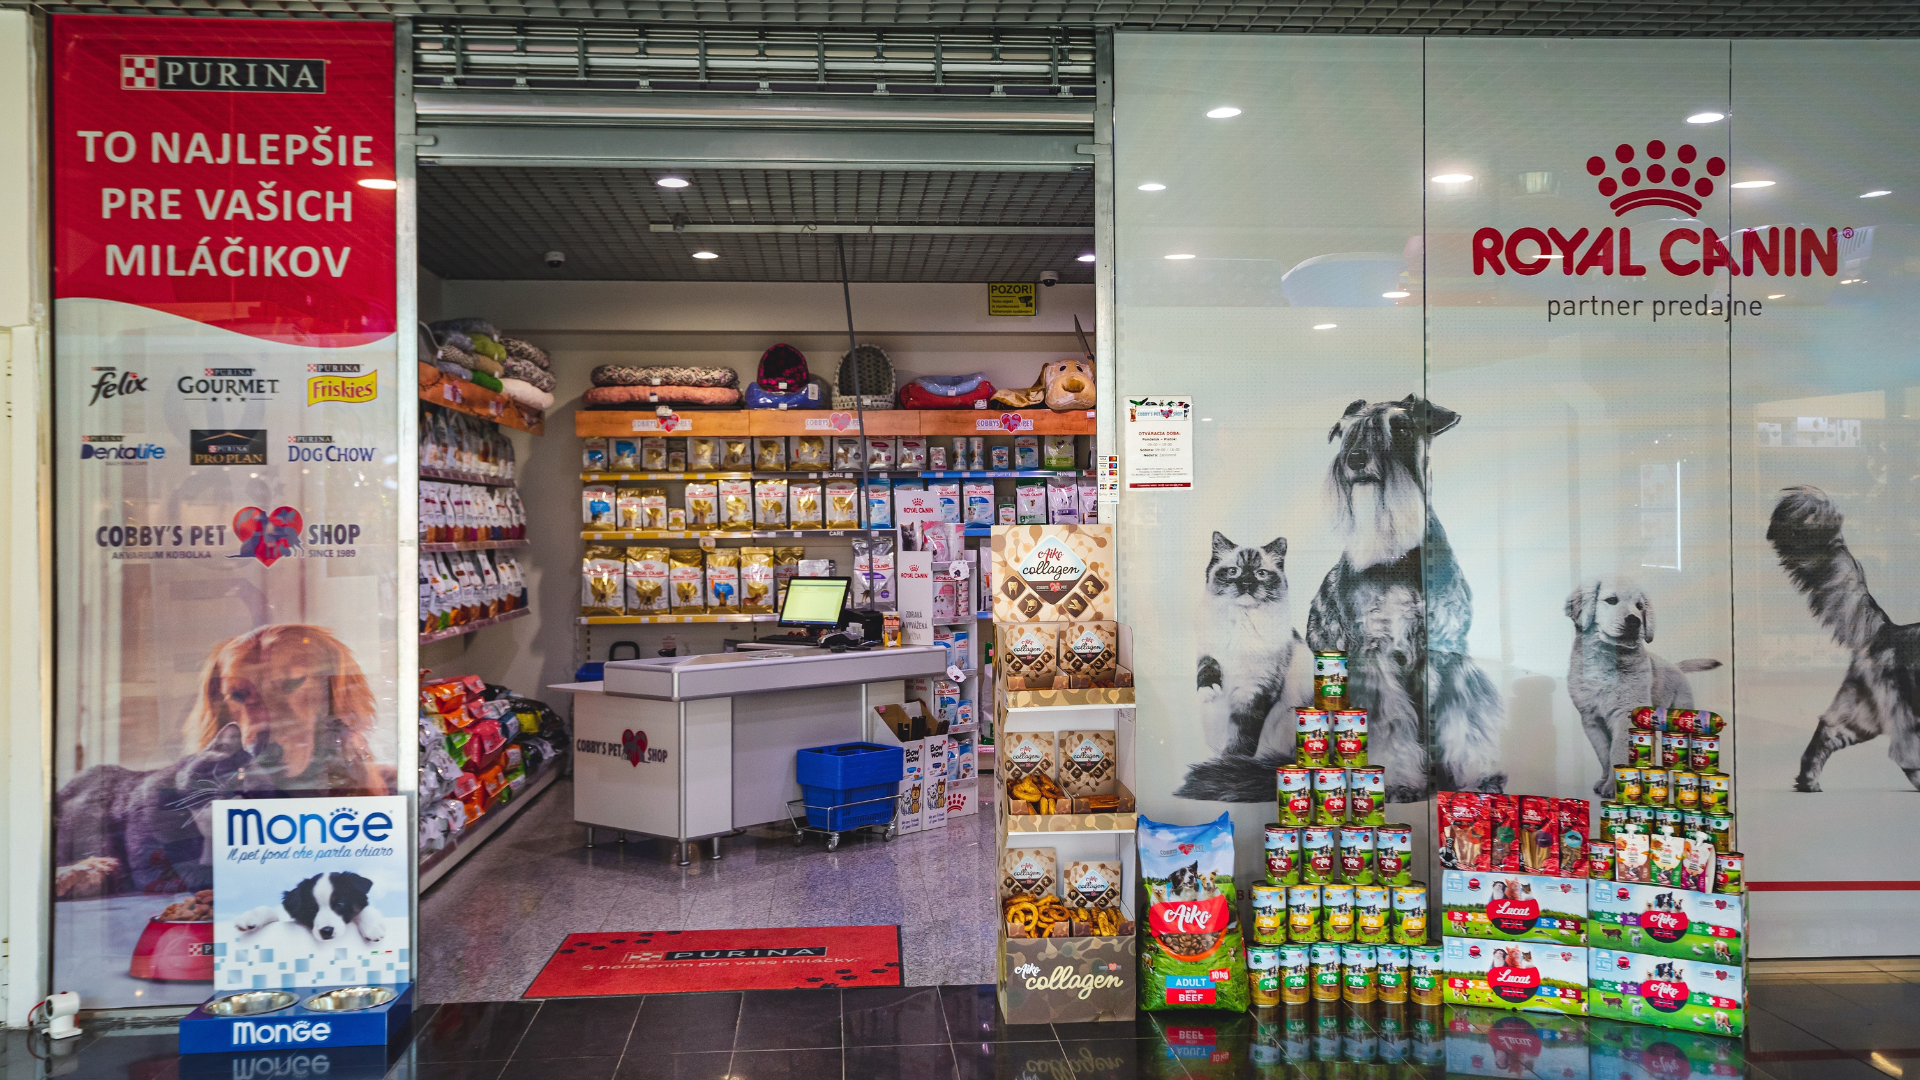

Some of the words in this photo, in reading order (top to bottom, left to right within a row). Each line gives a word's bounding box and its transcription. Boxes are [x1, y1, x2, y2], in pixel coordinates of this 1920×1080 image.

[164, 61, 319, 89] PURINA
[76, 130, 138, 164] TO
[150, 125, 374, 167] NAJLEPŠIE
[101, 187, 182, 220] PRE
[195, 180, 353, 223] VAŠICH
[104, 236, 352, 278] MILÁČIKOV
[1472, 226, 1647, 276] ROYAL
[1659, 227, 1839, 277] CANIN
[991, 285, 1032, 294] POZOR!
[1547, 295, 1644, 321] partner
[1652, 293, 1763, 322] predajne
[213, 368, 252, 376] PURINA
[316, 363, 360, 373] PURINA
[177, 376, 280, 396] GOURMET
[312, 380, 374, 399] Friskies
[976, 419, 1000, 427] COBBYS
[1022, 419, 1033, 427] PET
[195, 453, 225, 464] PRO
[225, 453, 264, 464] PLAN
[287, 445, 323, 462] DOG
[325, 445, 375, 462] CHOW
[96, 525, 183, 547] COBBY'S
[190, 525, 227, 547] PET
[308, 523, 361, 545] SHOP
[308, 549, 334, 558] SINCE
[336, 549, 356, 558] 1989
[1038, 548, 1064, 561] Aiko
[1022, 561, 1080, 580] collagen
[576, 739, 606, 755] COBBY'S
[608, 743, 622, 758] PET
[648, 748, 667, 763] SHOP
[237, 847, 260, 864] pet
[260, 846, 290, 865] food
[292, 845, 314, 859] che
[314, 845, 352, 862] parla
[354, 843, 394, 858] chiaro
[1496, 901, 1530, 916] Lucat
[1163, 904, 1212, 933] Aiko
[1650, 913, 1679, 928] Aiko
[674, 948, 815, 959] PURINA
[1014, 963, 1041, 979] Aiko
[1497, 969, 1531, 984] Lucat
[1026, 965, 1124, 1000] collagen
[1175, 978, 1206, 987] ADULT
[1650, 983, 1679, 998] Aiko
[1179, 994, 1204, 1002] BEEF
